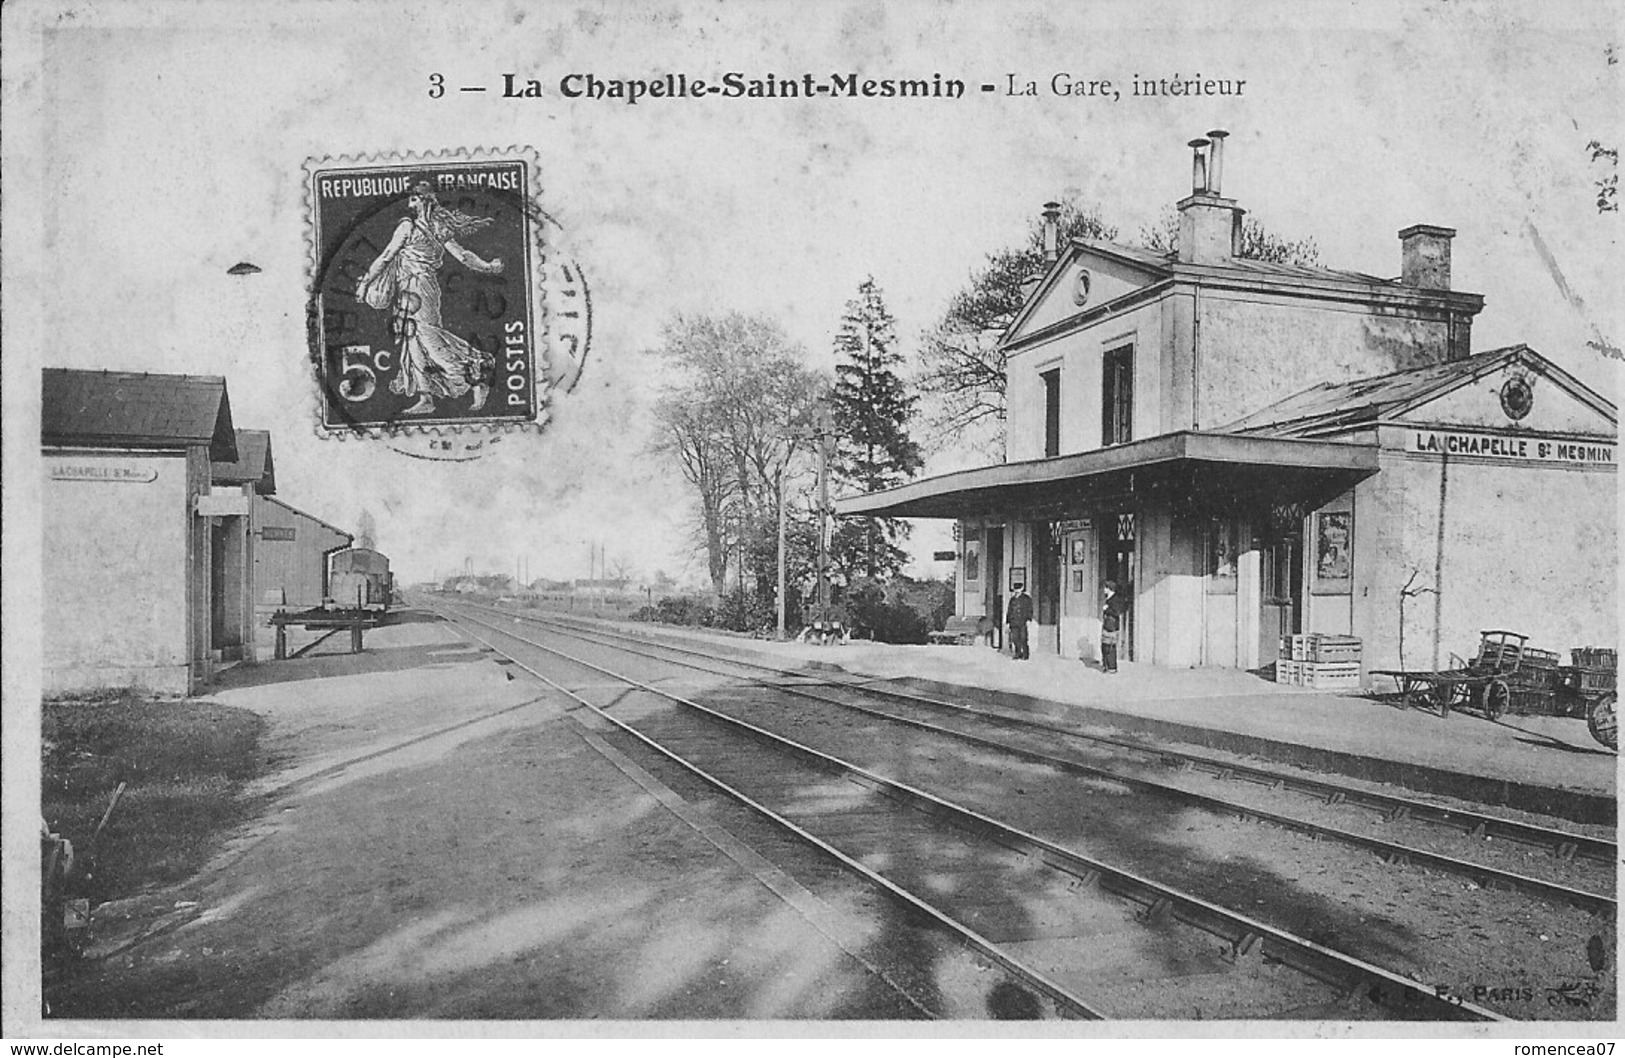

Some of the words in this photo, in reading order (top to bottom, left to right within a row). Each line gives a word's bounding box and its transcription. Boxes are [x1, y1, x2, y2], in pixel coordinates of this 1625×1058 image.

[321, 175, 411, 199] REPUBLIQUE
[504, 320, 527, 406] POSTES
[1416, 433, 1438, 451] LA
[1447, 436, 1528, 457] CHAPELLE
[1557, 443, 1612, 462] MESMIN
